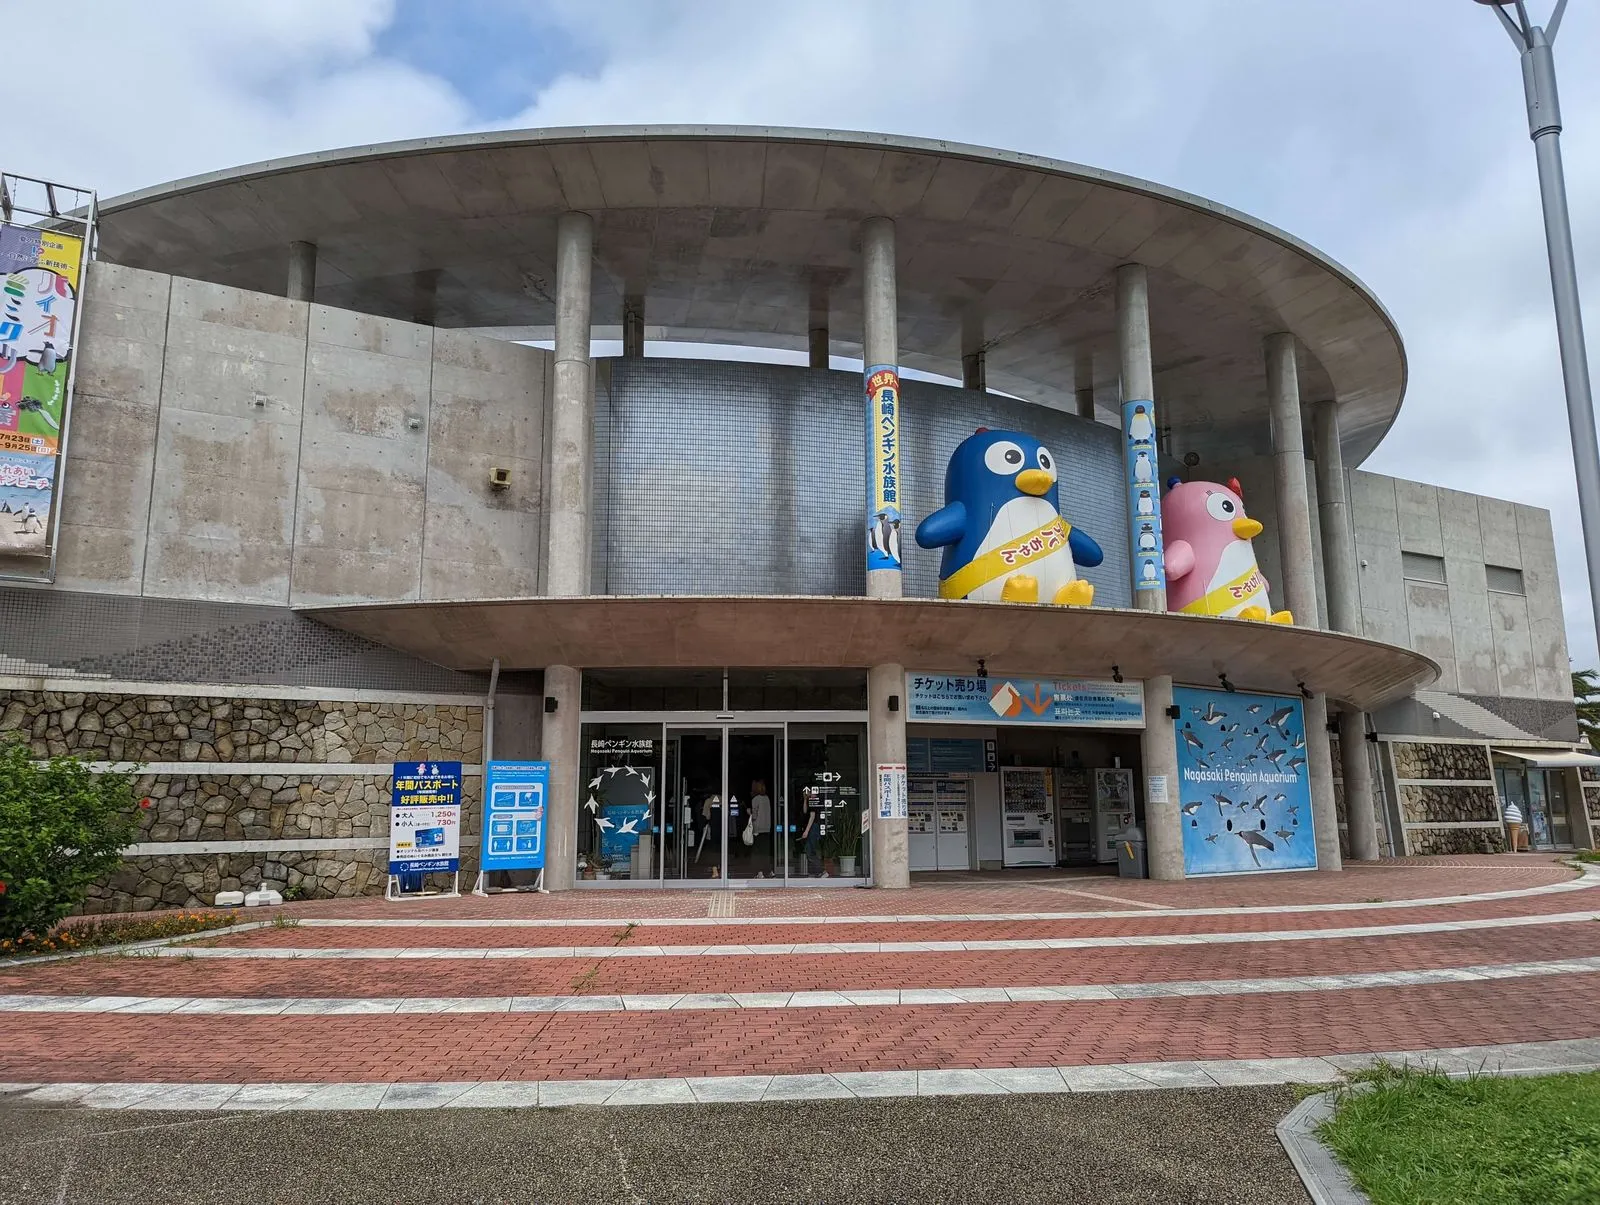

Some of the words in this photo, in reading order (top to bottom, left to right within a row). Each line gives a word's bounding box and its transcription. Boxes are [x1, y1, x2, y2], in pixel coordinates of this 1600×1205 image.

[881, 389, 897, 503] 長崎ペンギン水族館
[0, 465, 34, 477] れあい
[914, 677, 987, 693] チケット売り場
[1053, 681, 1088, 691] Tickets
[591, 739, 653, 748] 長崎ペンギン水族館
[1184, 767, 1224, 784] Nagasaki
[1225, 768, 1258, 785] Penguin
[1259, 771, 1298, 785] Aquarium
[395, 779, 458, 790] 年間パスポート
